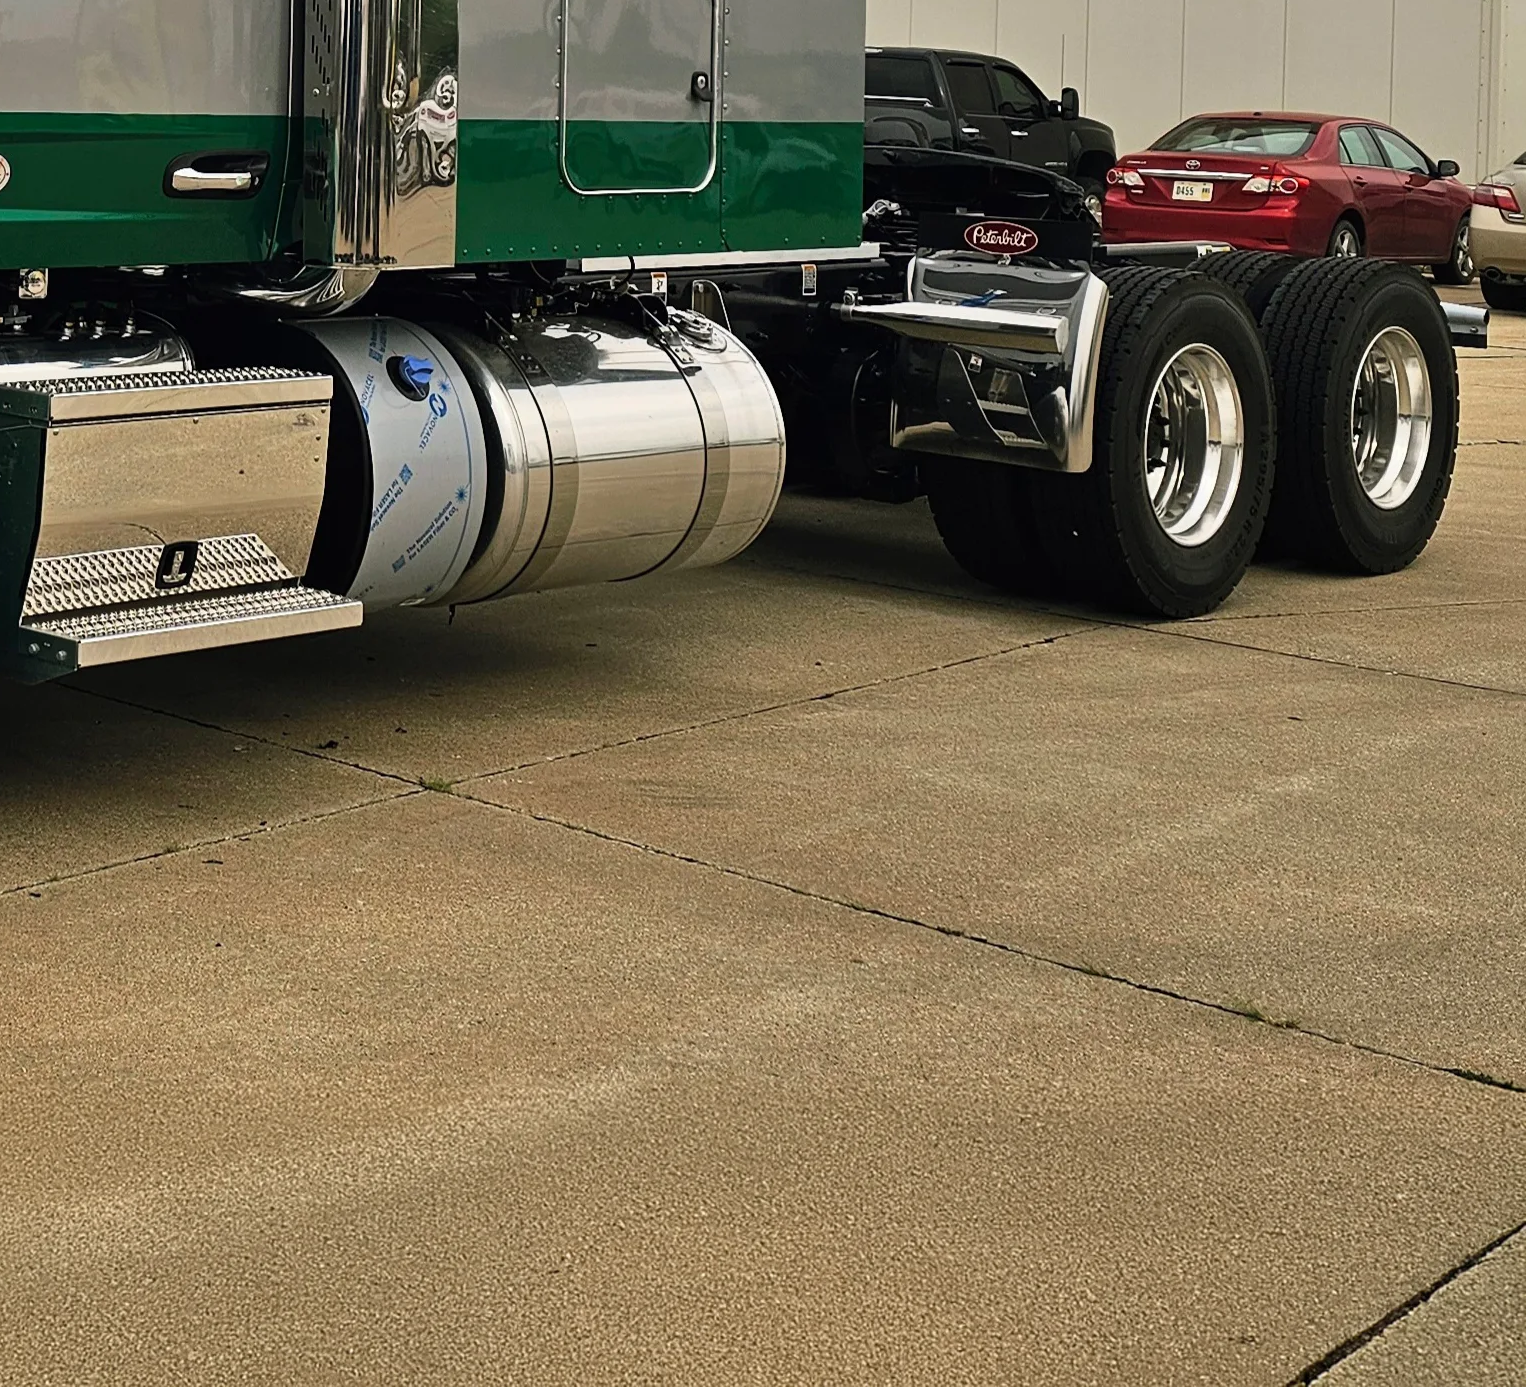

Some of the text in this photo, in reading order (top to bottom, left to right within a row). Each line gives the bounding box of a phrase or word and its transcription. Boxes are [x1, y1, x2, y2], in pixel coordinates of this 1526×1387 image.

[973, 226, 1032, 247] Peterbilt
[361, 373, 374, 404] NOVACEL
[419, 415, 438, 449] NOVACEL
